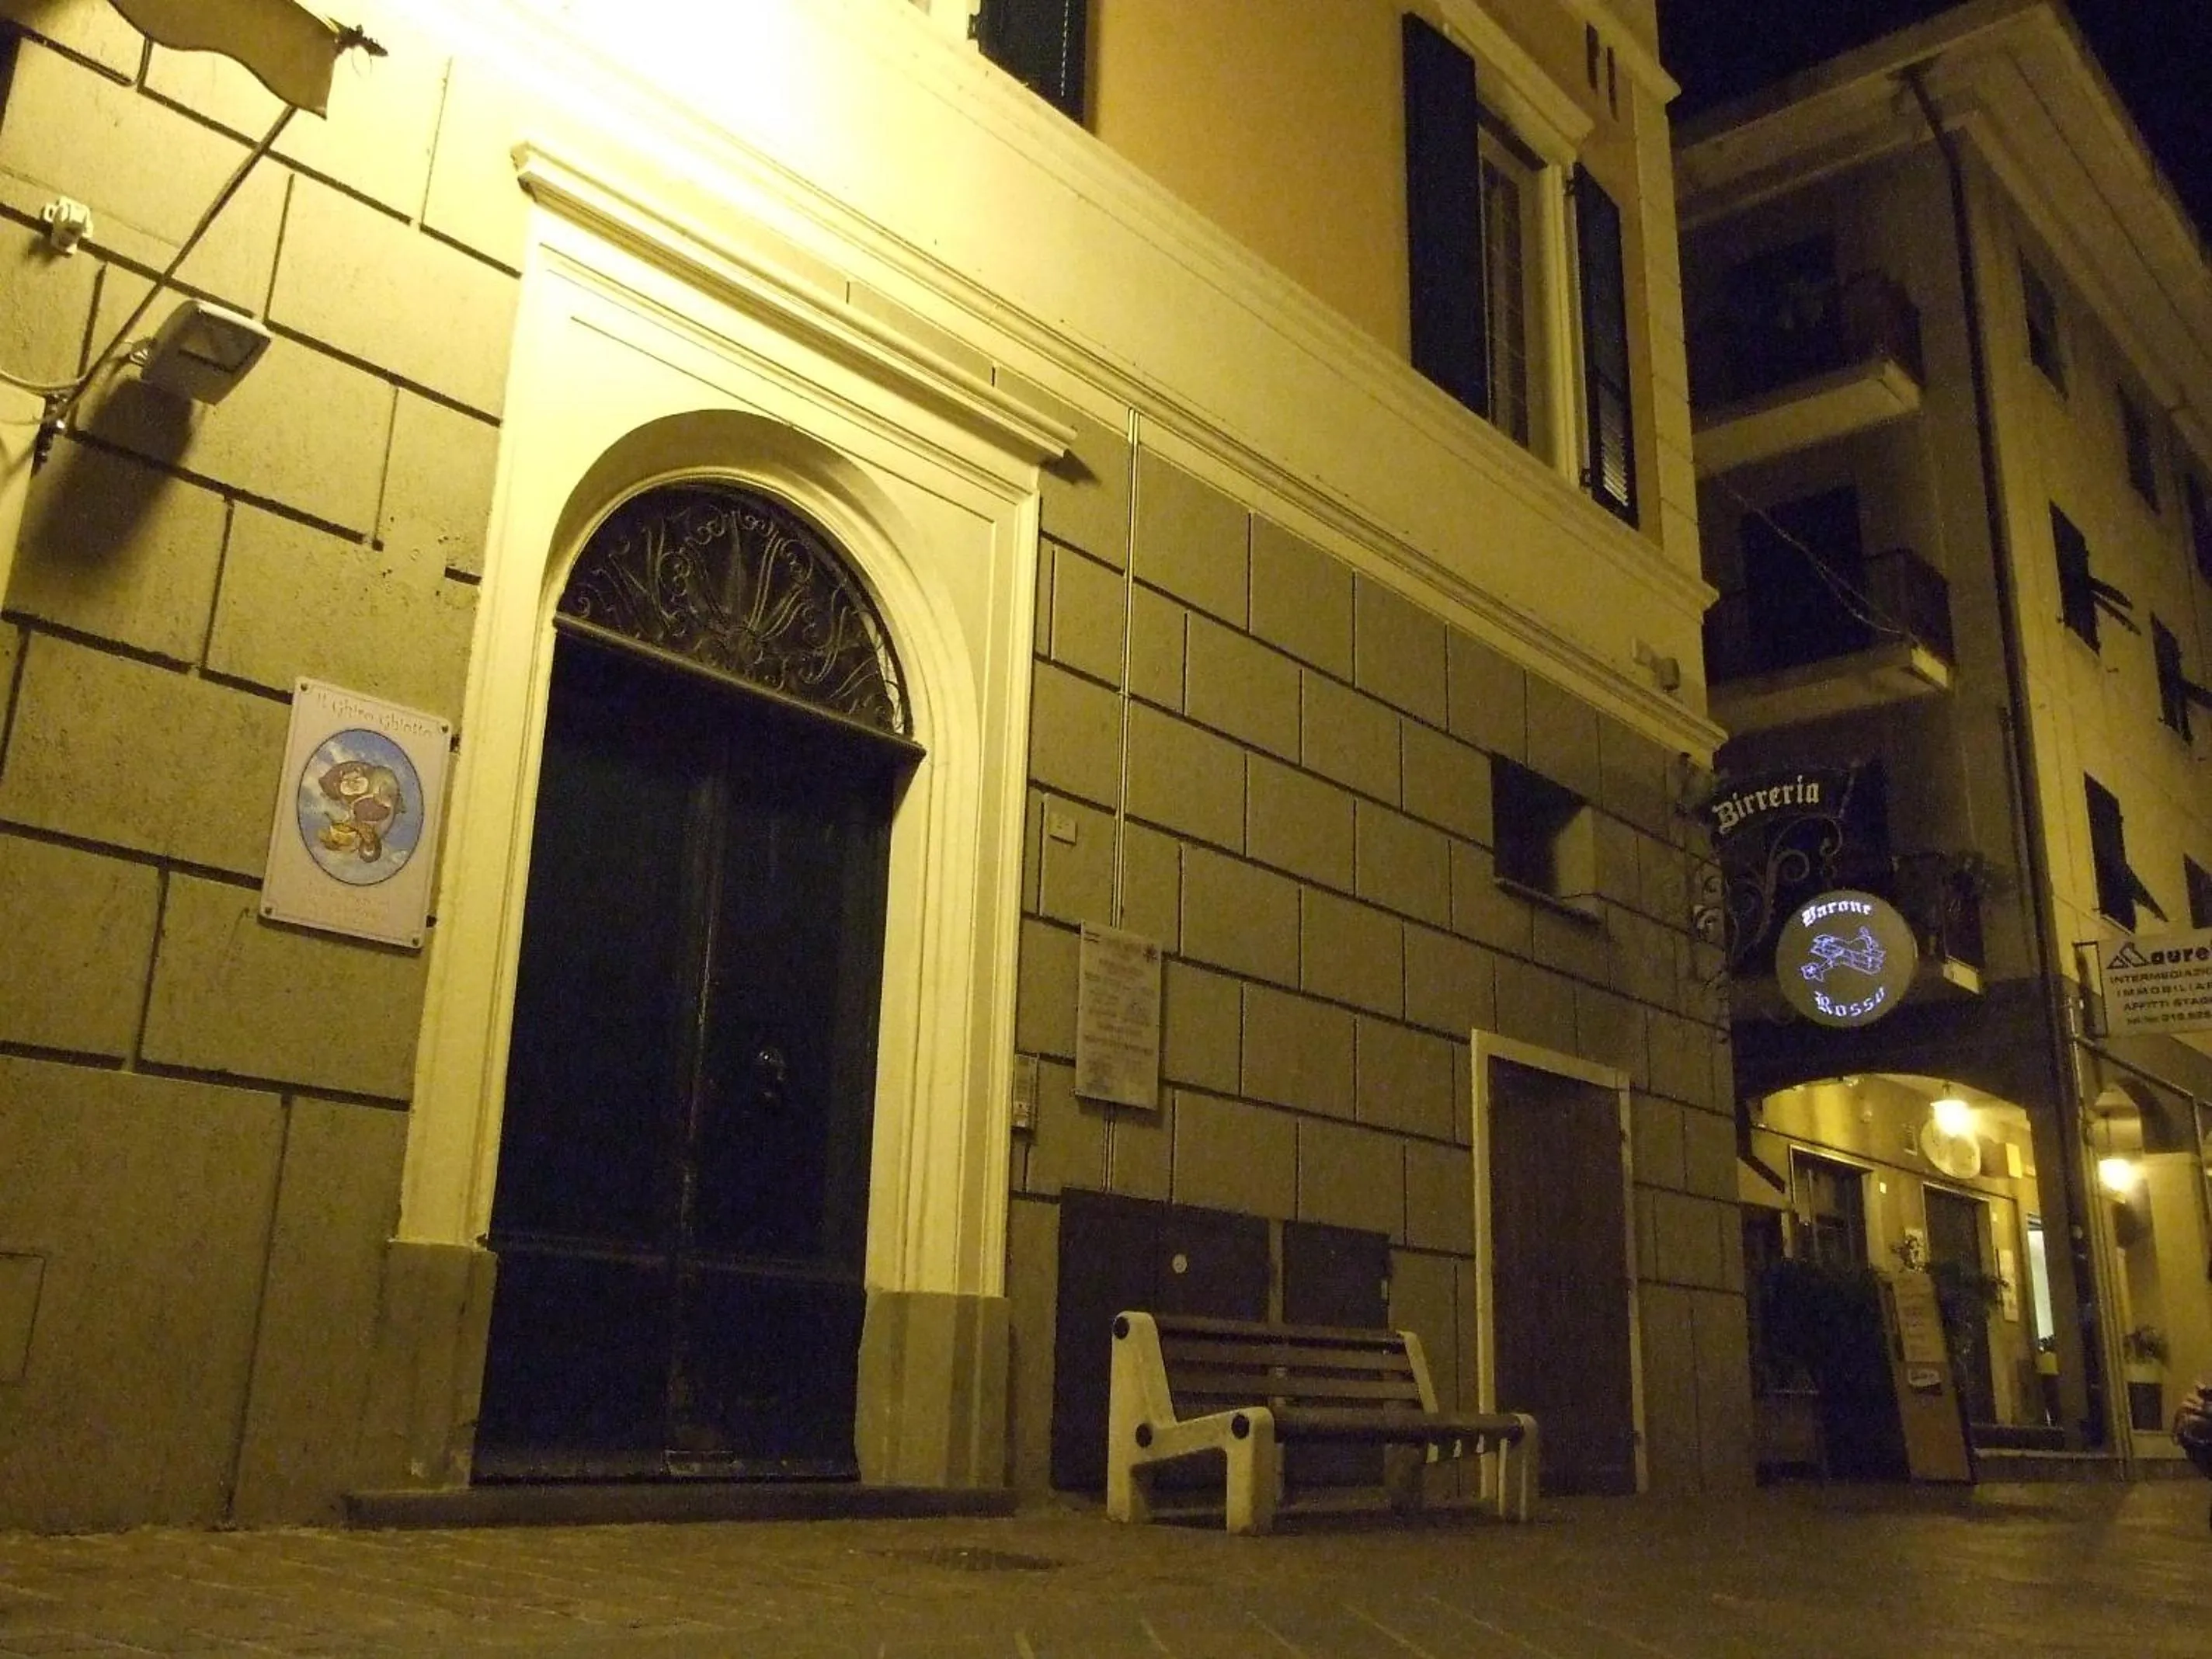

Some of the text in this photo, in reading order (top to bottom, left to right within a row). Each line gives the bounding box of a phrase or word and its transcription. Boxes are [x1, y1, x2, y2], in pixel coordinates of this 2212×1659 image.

[1711, 774, 1820, 835] Birreria
[1801, 900, 1873, 928] Barone
[1814, 986, 1885, 1017] Rosso
